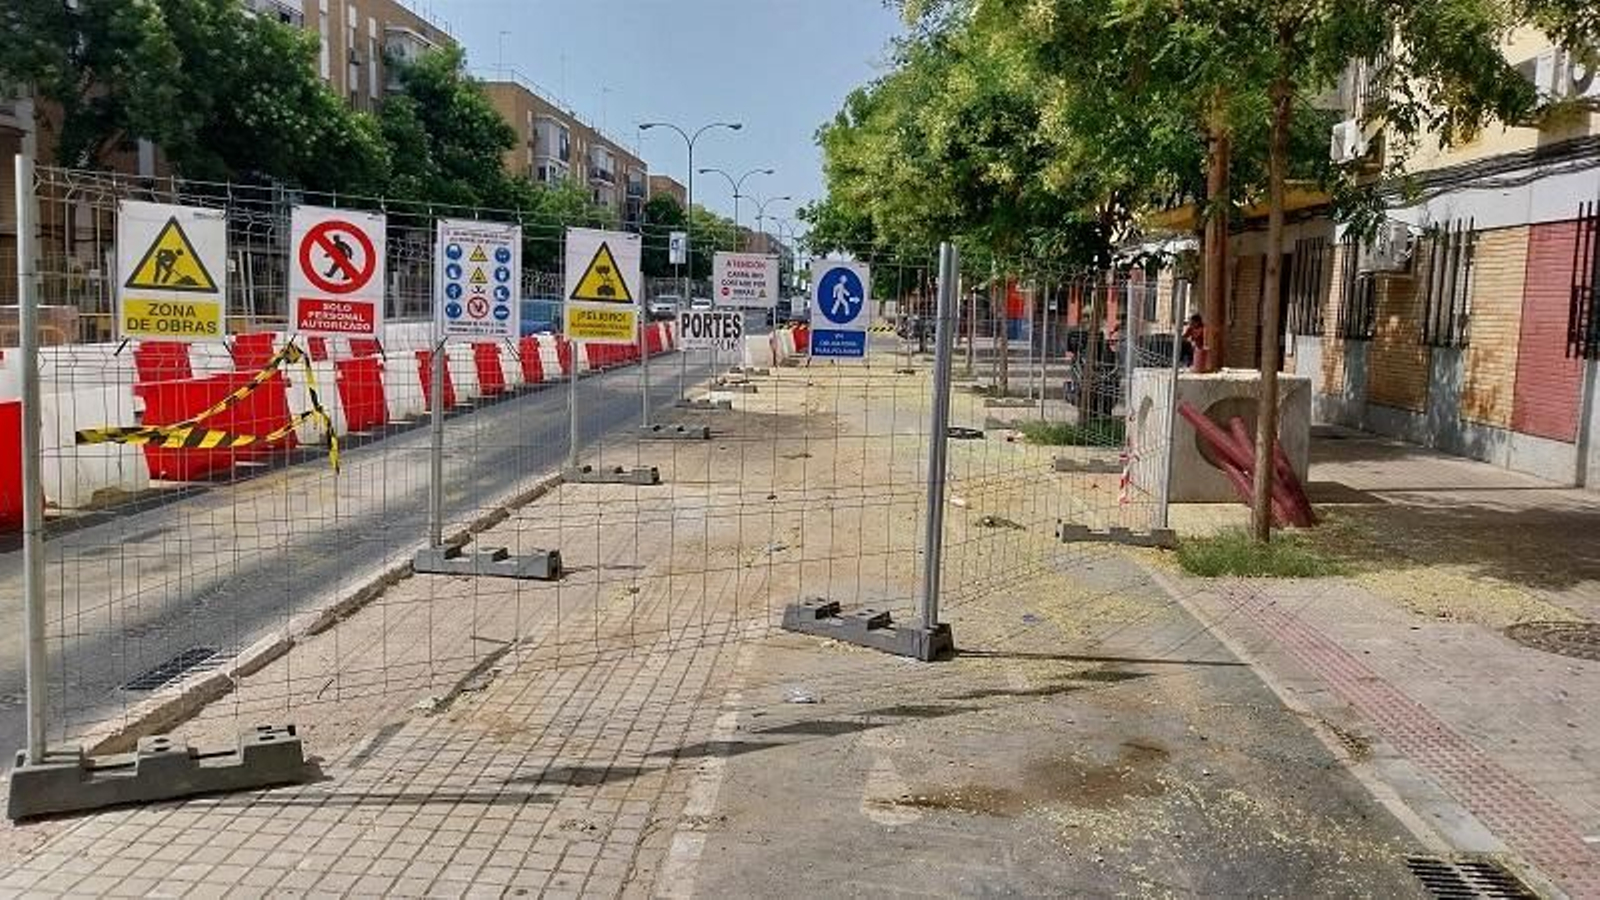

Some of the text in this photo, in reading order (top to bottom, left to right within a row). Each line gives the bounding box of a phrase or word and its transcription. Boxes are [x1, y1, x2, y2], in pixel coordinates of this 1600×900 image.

[148, 303, 196, 318] ZONA
[307, 311, 365, 322] PERSONAL
[127, 318, 217, 334] DE OBRAS
[301, 320, 371, 331] AUTORIZADO
[681, 313, 742, 338] PORTES
